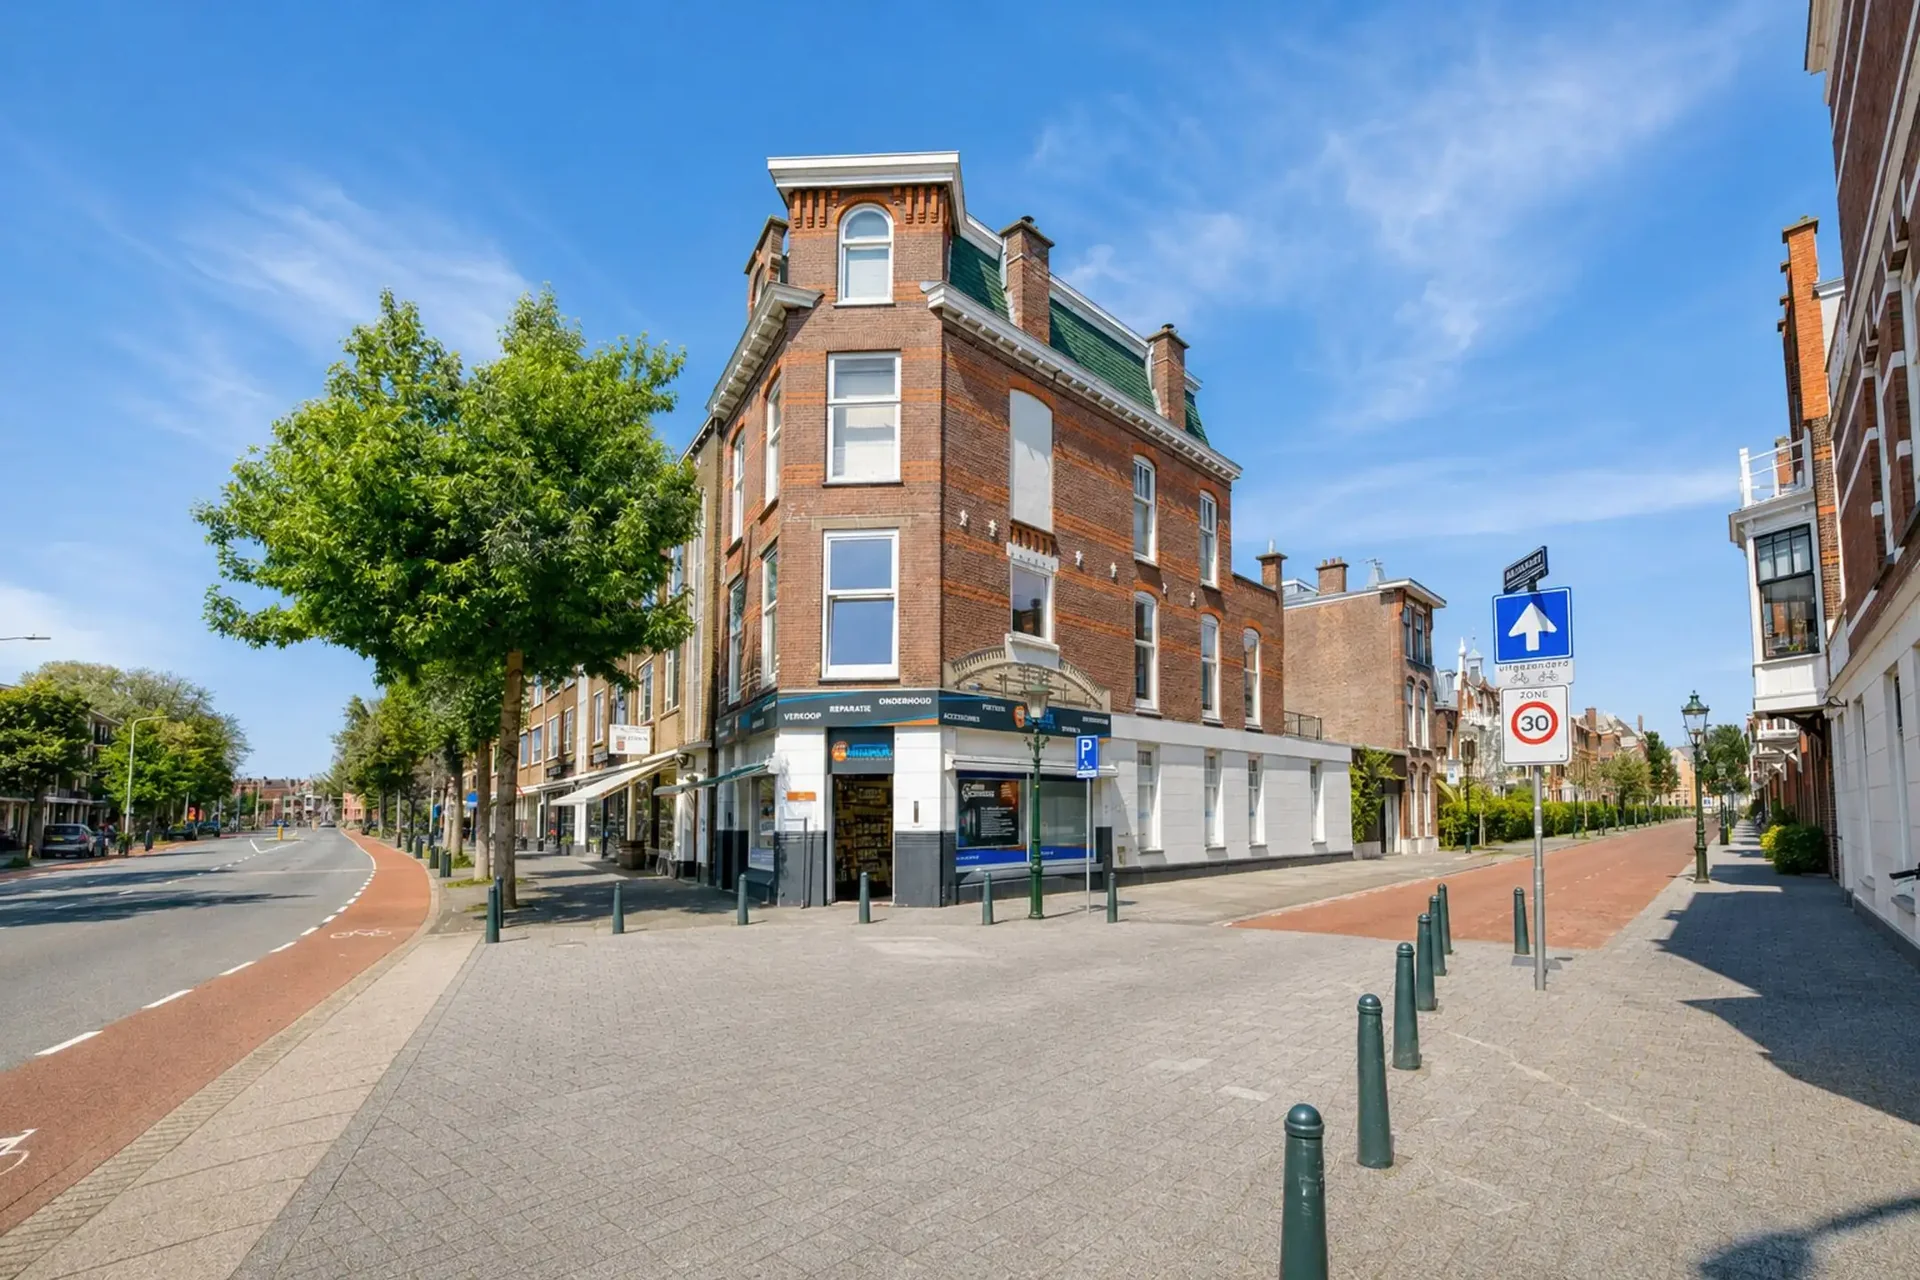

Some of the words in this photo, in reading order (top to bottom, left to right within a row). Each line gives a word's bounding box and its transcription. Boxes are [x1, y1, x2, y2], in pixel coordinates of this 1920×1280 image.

[1499, 660, 1569, 673] uitgezonderd
[1519, 690, 1549, 699] ZONE
[878, 697, 932, 705] ONDERHOUD
[829, 704, 871, 713] REPARATIE
[783, 712, 822, 721] VERKOOP
[1520, 714, 1549, 732] 30
[1081, 738, 1093, 760] P
